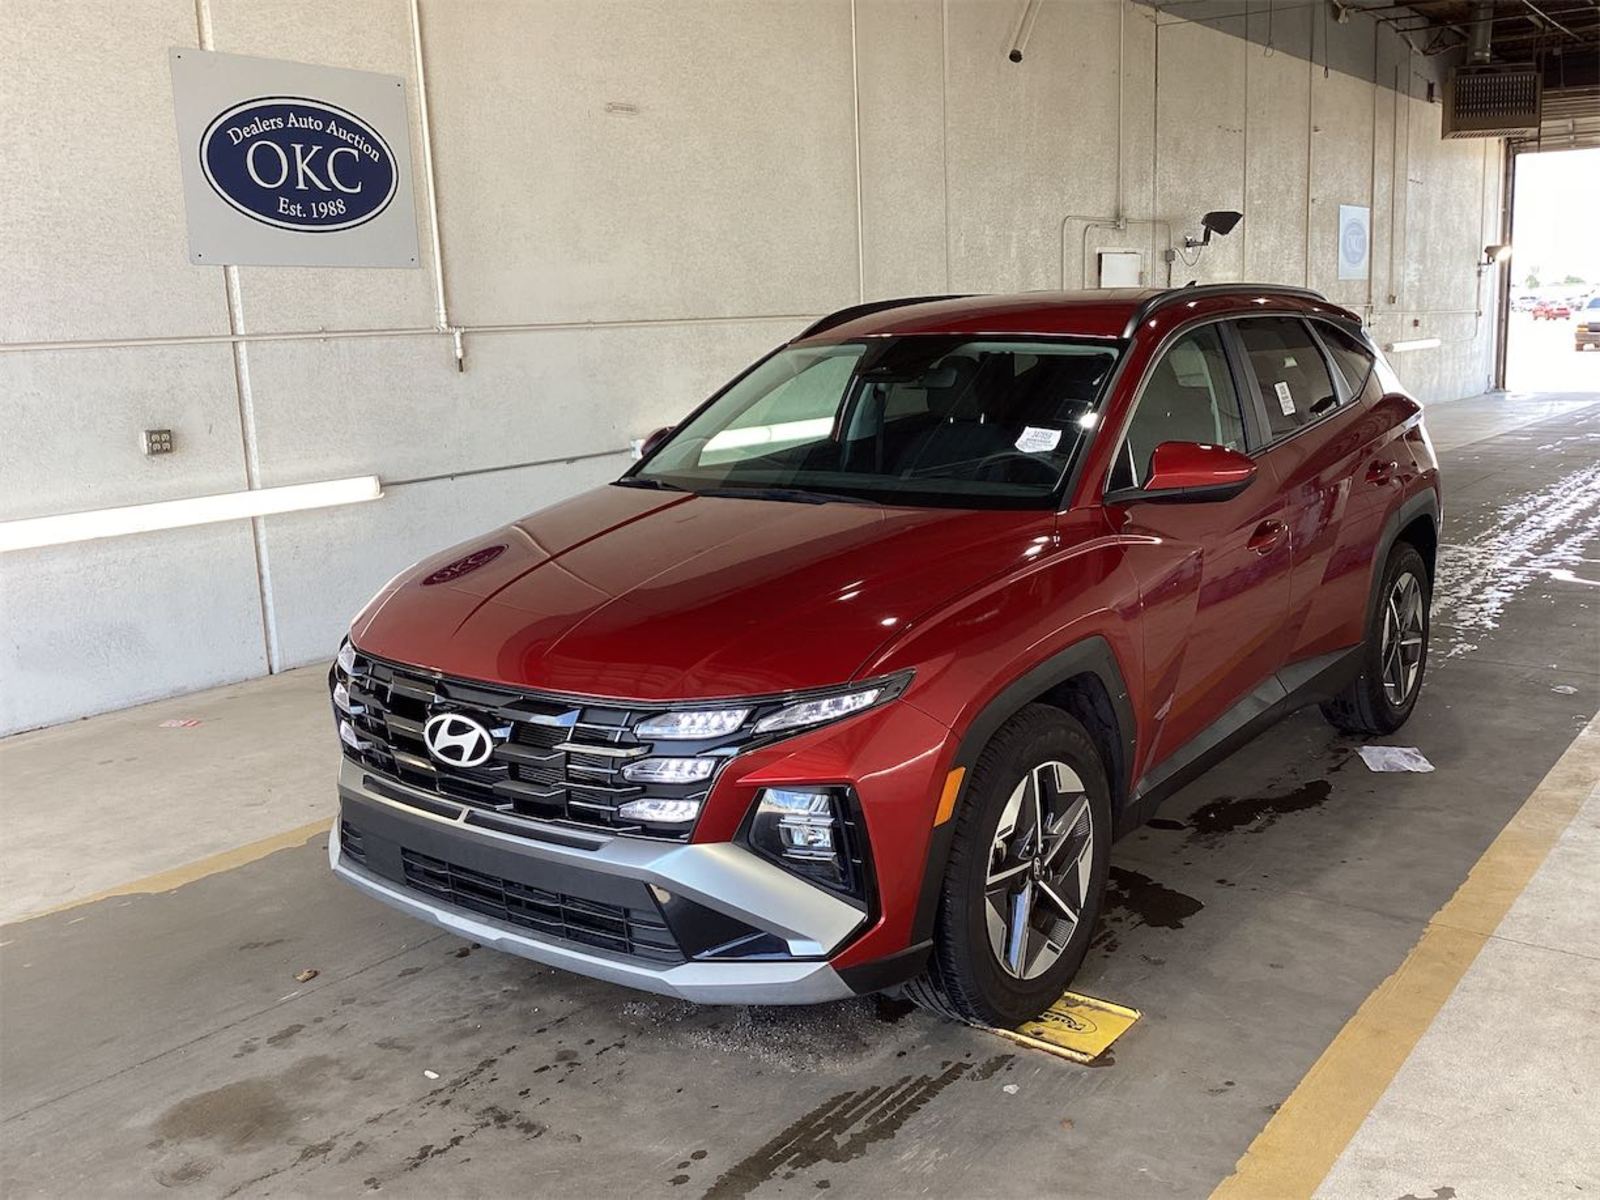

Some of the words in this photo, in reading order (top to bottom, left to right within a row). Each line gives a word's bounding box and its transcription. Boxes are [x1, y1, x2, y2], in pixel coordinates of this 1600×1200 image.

[226, 116, 284, 145] Dealers
[286, 112, 323, 131] Auto
[325, 120, 380, 163] Auction
[246, 140, 362, 194] OKC
[277, 197, 306, 218] Est.
[311, 199, 346, 219] 1988
